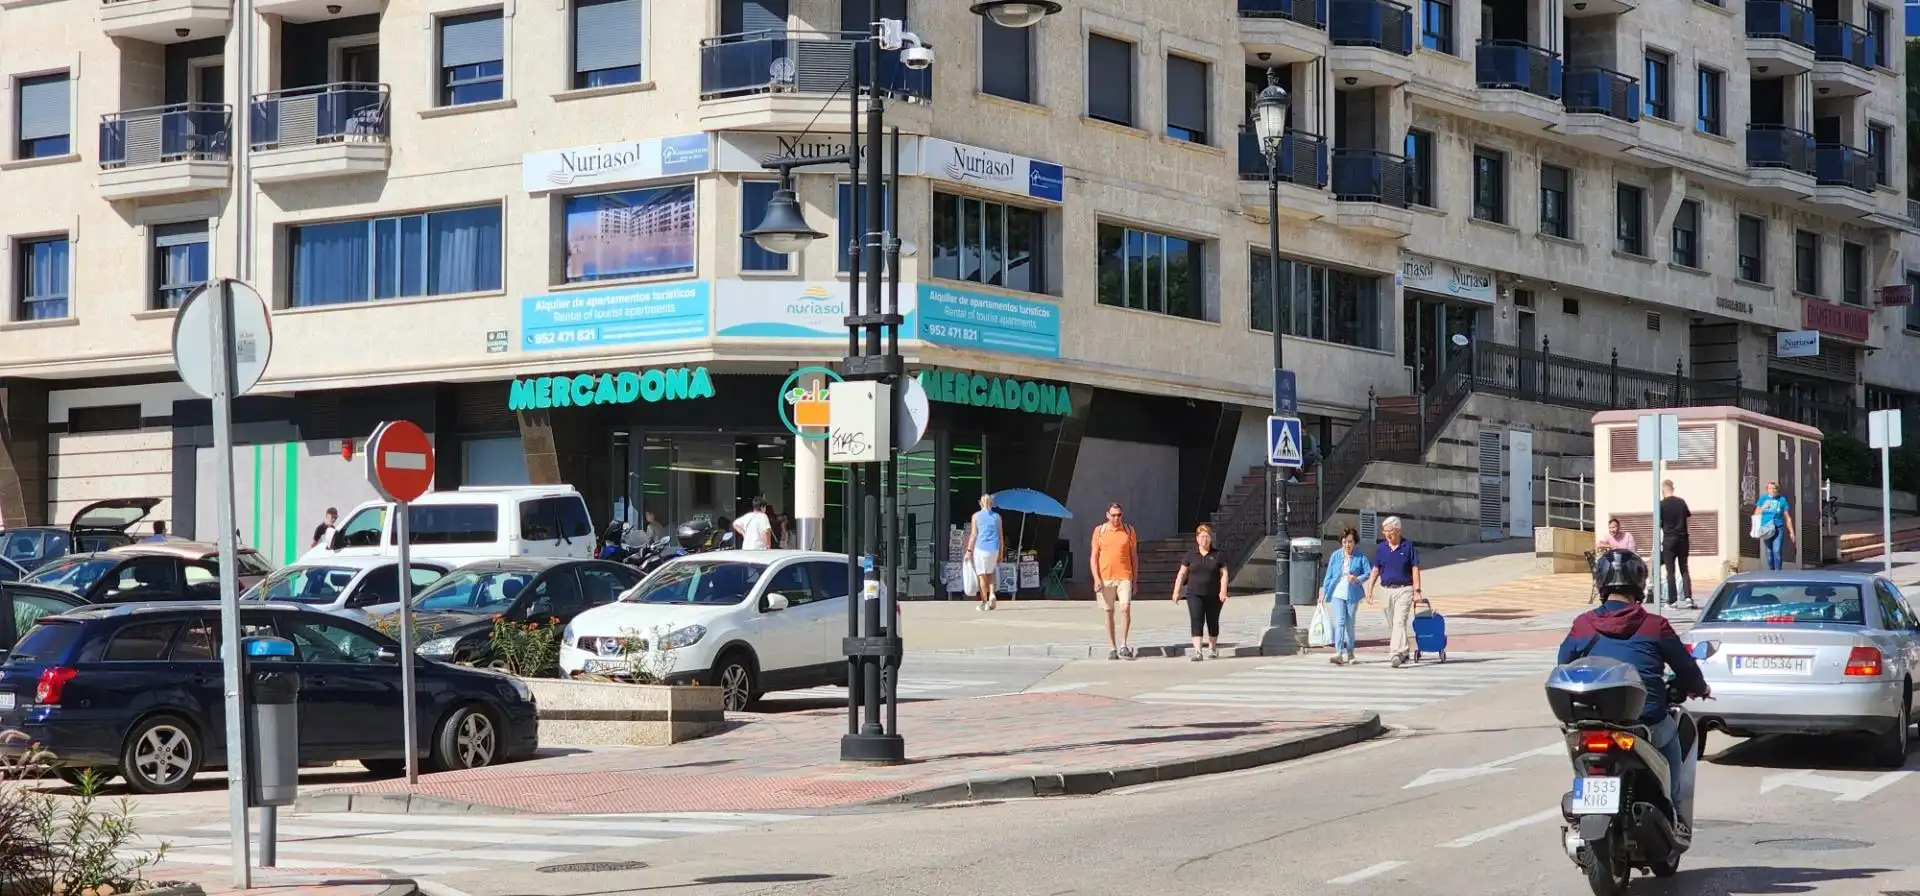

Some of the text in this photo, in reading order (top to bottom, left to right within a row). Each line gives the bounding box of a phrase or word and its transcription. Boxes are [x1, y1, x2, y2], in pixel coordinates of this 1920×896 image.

[560, 143, 641, 173] Nuriasol
[953, 146, 1015, 177] Nuriasol
[1452, 266, 1492, 287] Nuriasol
[535, 298, 569, 312] Alquiler
[572, 297, 584, 308] de
[586, 292, 650, 307] apartamentos
[786, 301, 844, 315] nuriasol
[929, 290, 957, 304] Alquiler
[959, 295, 968, 306] de
[970, 298, 1018, 313] apartamentos
[554, 303, 677, 322] Rental of tourist apartments
[944, 305, 1037, 329] Rental of tourist apartments
[535, 331, 555, 344] 952
[557, 330, 575, 343] 471
[929, 324, 946, 337] 952
[948, 327, 961, 339] 471
[963, 328, 977, 340] 821
[508, 366, 716, 411] MERCADONA
[918, 367, 1073, 417] MERCADONA
[1744, 658, 1803, 670] CE 0534 H
[1586, 781, 1617, 793] 1535
